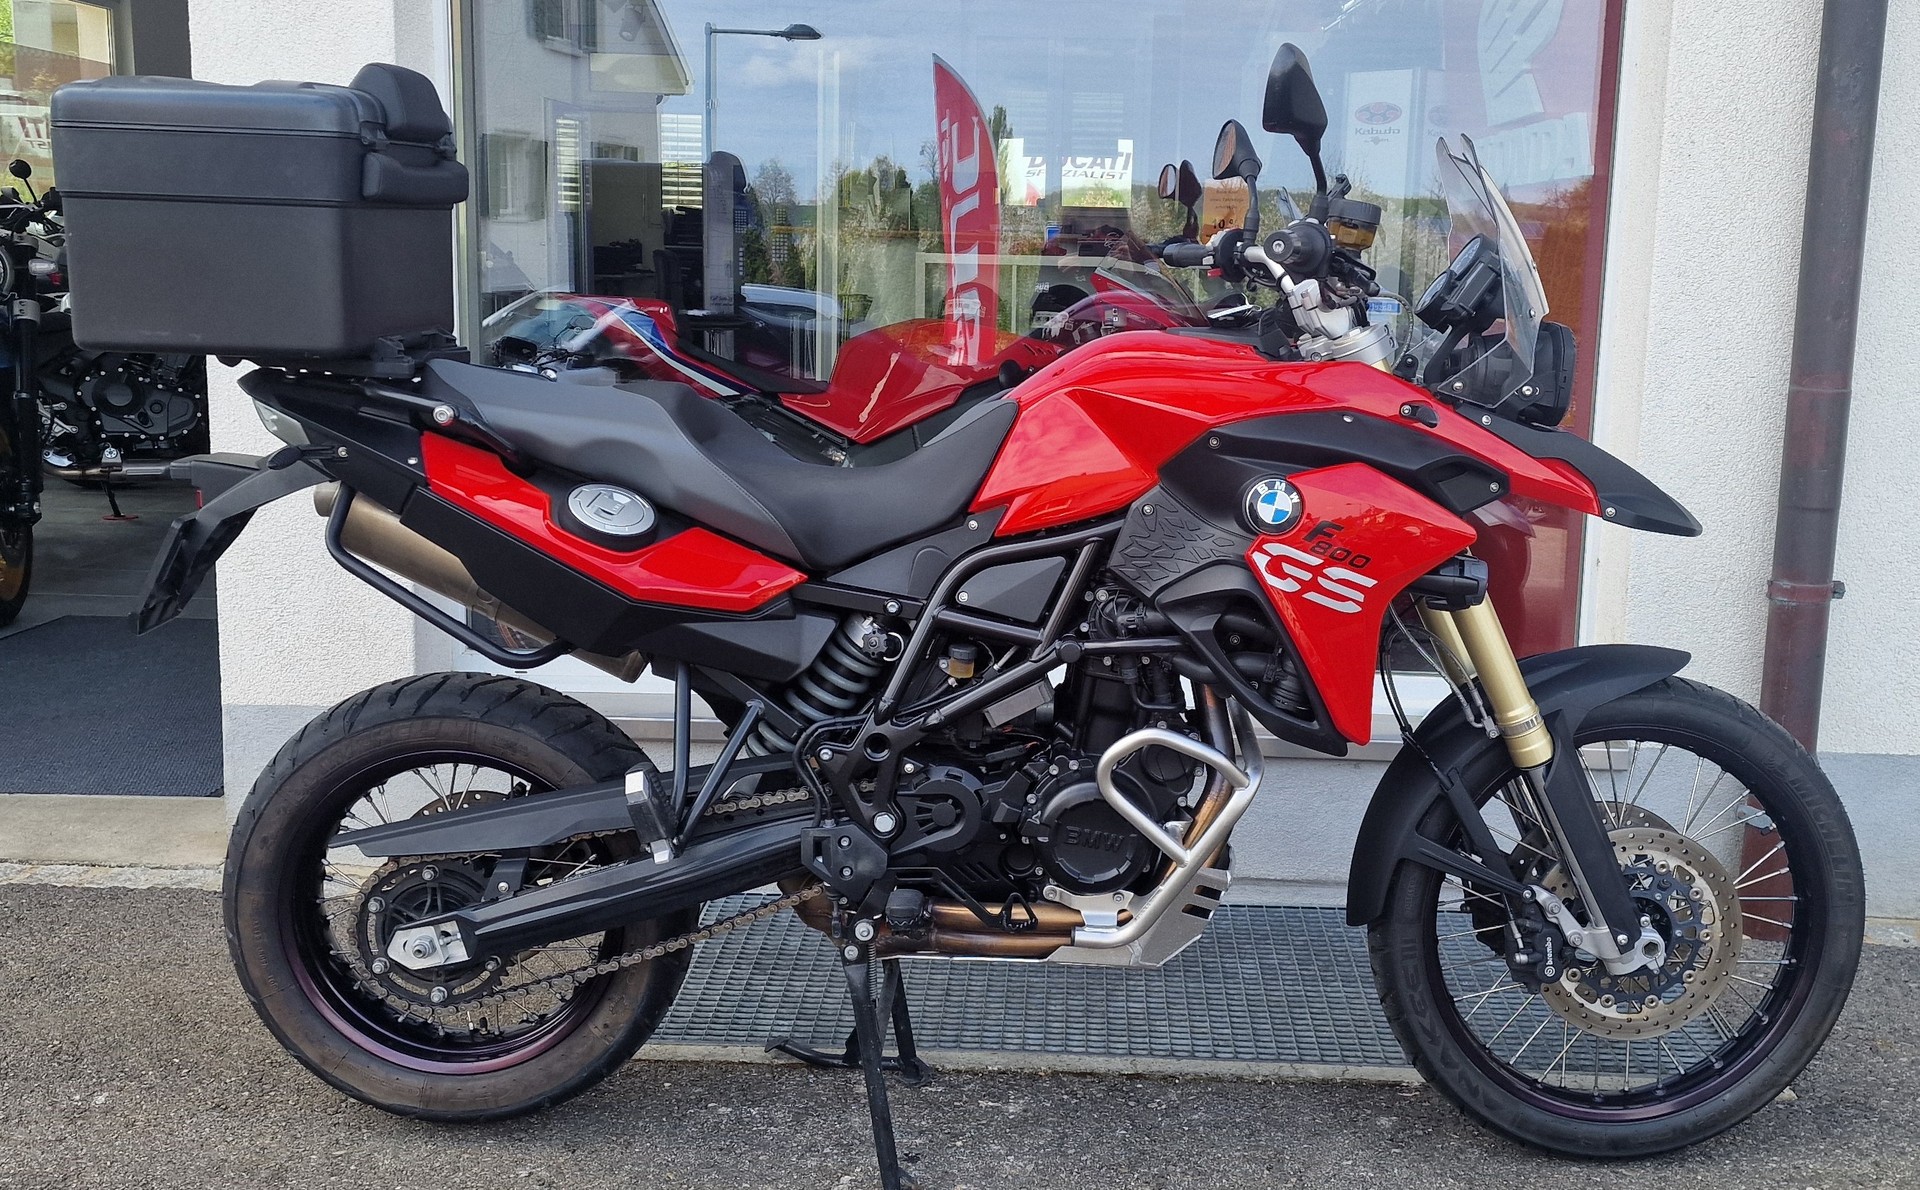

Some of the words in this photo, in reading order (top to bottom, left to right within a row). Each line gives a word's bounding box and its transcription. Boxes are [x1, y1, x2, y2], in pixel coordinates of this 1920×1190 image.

[1028, 152, 1132, 170] DCATI
[1256, 480, 1301, 504] BMW
[1302, 520, 1345, 542] F
[1310, 541, 1372, 569] 800
[1252, 543, 1378, 613] GS
[1064, 825, 1124, 853] BMW
[1545, 936, 1553, 966] brembo
